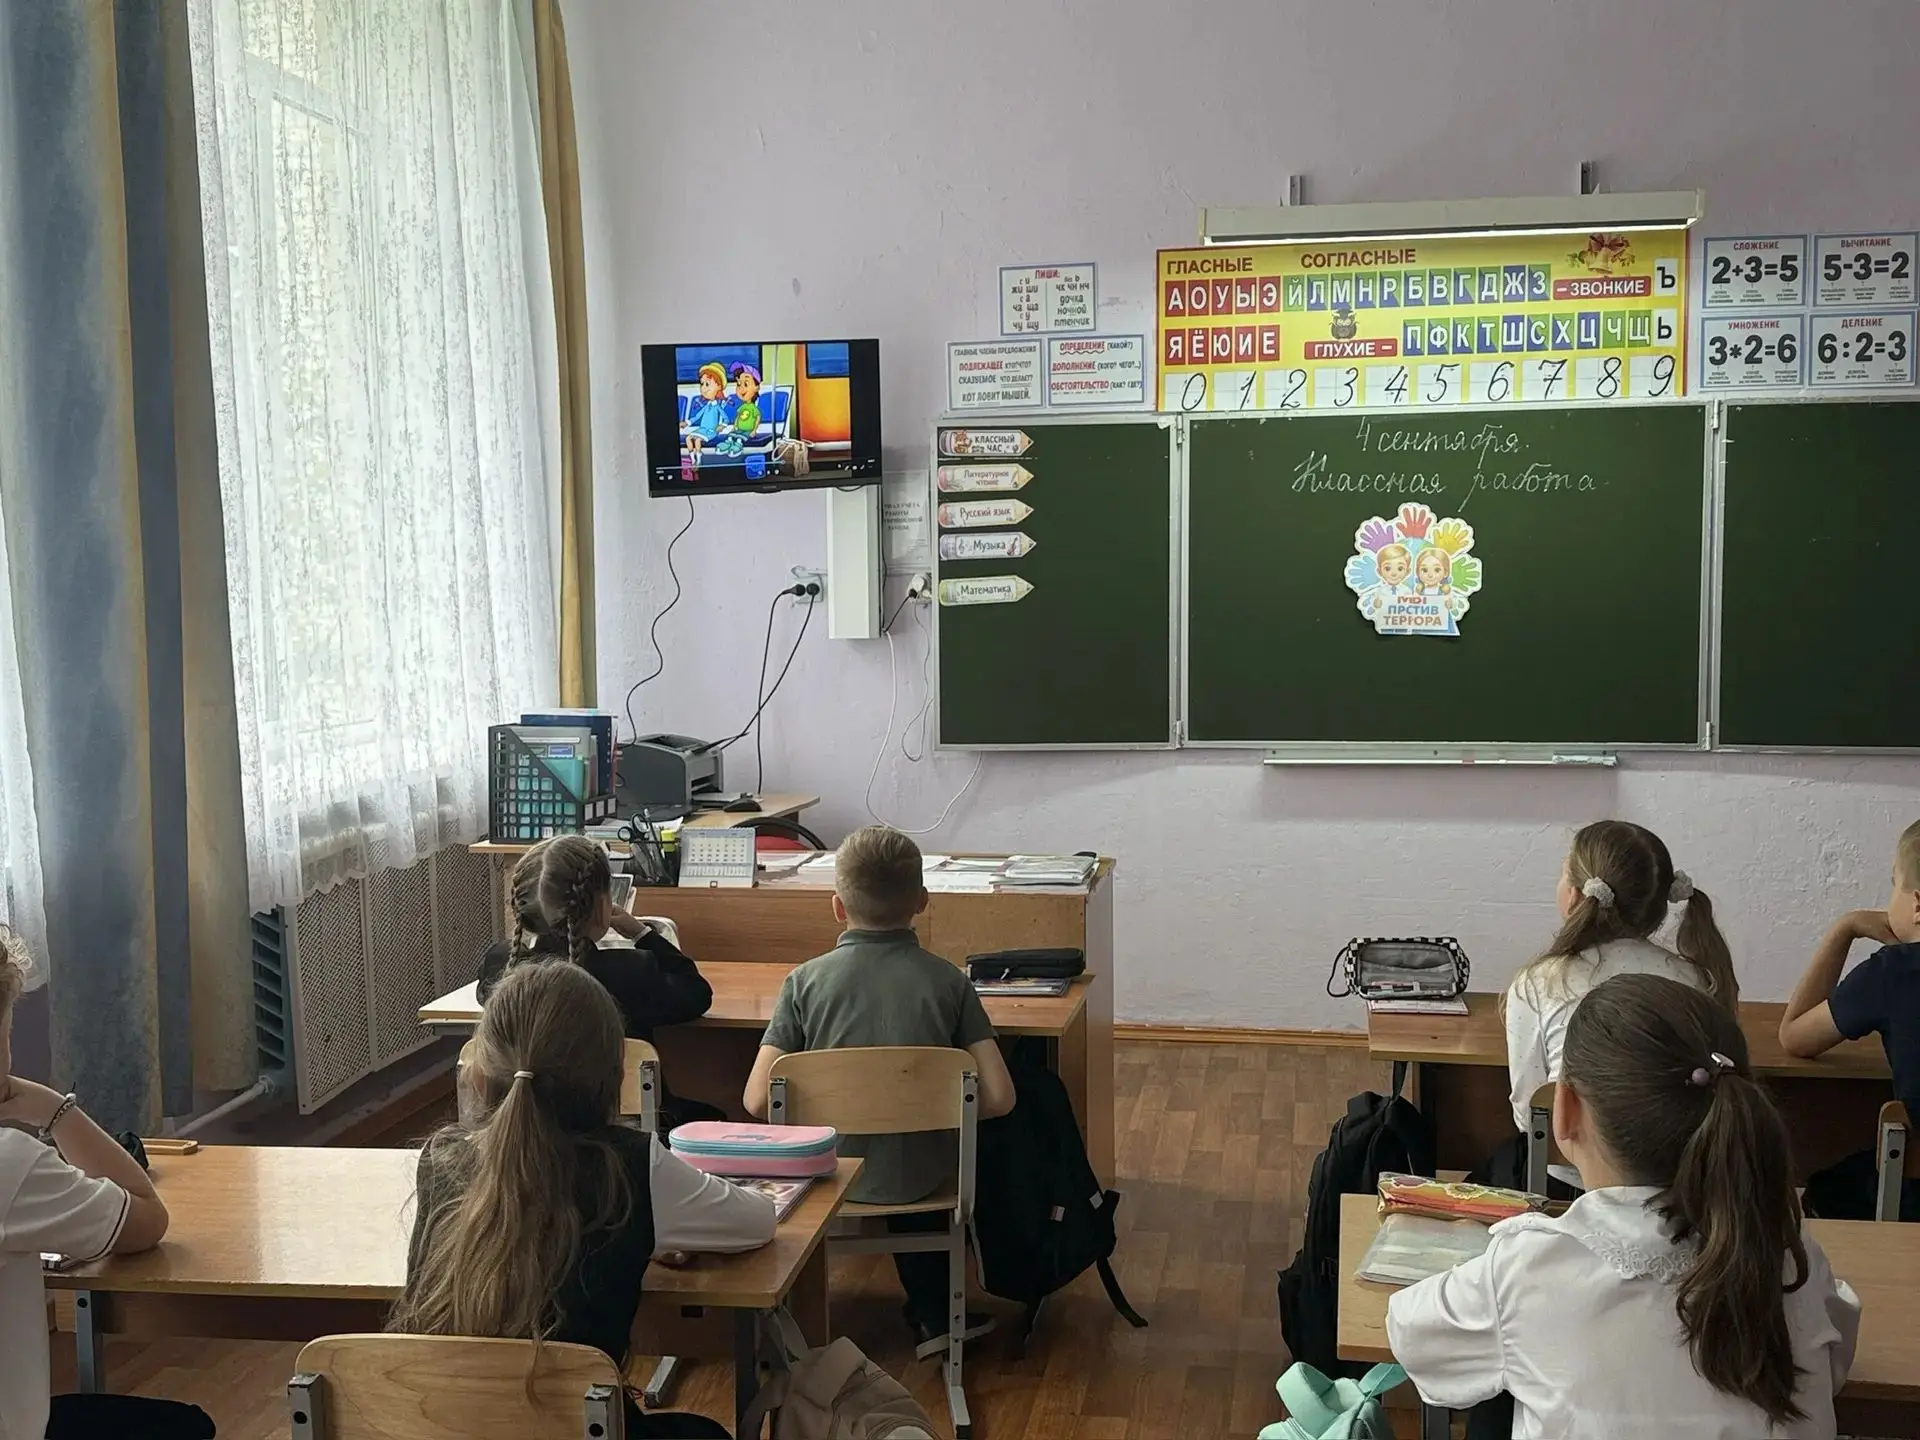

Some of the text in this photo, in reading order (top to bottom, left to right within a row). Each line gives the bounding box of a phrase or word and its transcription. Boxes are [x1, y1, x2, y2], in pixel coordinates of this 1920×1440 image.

[1733, 241, 1779, 251] СЛОЖЕНИЕ
[1840, 238, 1892, 249] ВЫЧИТАНИЕ
[1301, 248, 1416, 268] СОГЛАСНЫЕ
[1166, 256, 1253, 274] ГЛАСНЫЕ
[1711, 254, 1799, 284] 2+3=5
[1823, 251, 1910, 281] 5-3=2
[1035, 269, 1060, 279] ПИШИ:
[1570, 279, 1645, 296] ЗВОНКИЕ
[1656, 266, 1676, 289] Ъ
[1728, 320, 1780, 330] УМНОЖЕНИЕ
[1841, 318, 1883, 329] ДЕЛЕНИЕ
[1059, 341, 1105, 351] ОПРЕДЕЛЕНИЕ
[1314, 341, 1375, 357] ГЛУХИЕ
[959, 360, 1003, 371] ПОДЛЕЖАЩЕЕ
[1052, 361, 1096, 371] ДОПОЛНЕНИЕ
[958, 374, 996, 385] СКАЗУЕМОЕ
[1181, 354, 1676, 411] 0 1 2 3 4 5 6 7 8 9
[1051, 380, 1109, 391] ОБСТОЯТЕЛЬСТВО
[962, 392, 976, 402] КОТ
[976, 391, 1000, 402] ЛОВИТ
[974, 434, 1015, 443] КЛАССНЫЙ
[1355, 416, 1371, 451] 4
[987, 444, 1002, 453] ЧАС
[1291, 450, 1447, 493] Классная
[959, 506, 1011, 520] Русский язык
[973, 540, 1006, 552] Музыка
[960, 585, 1011, 595] Математика
